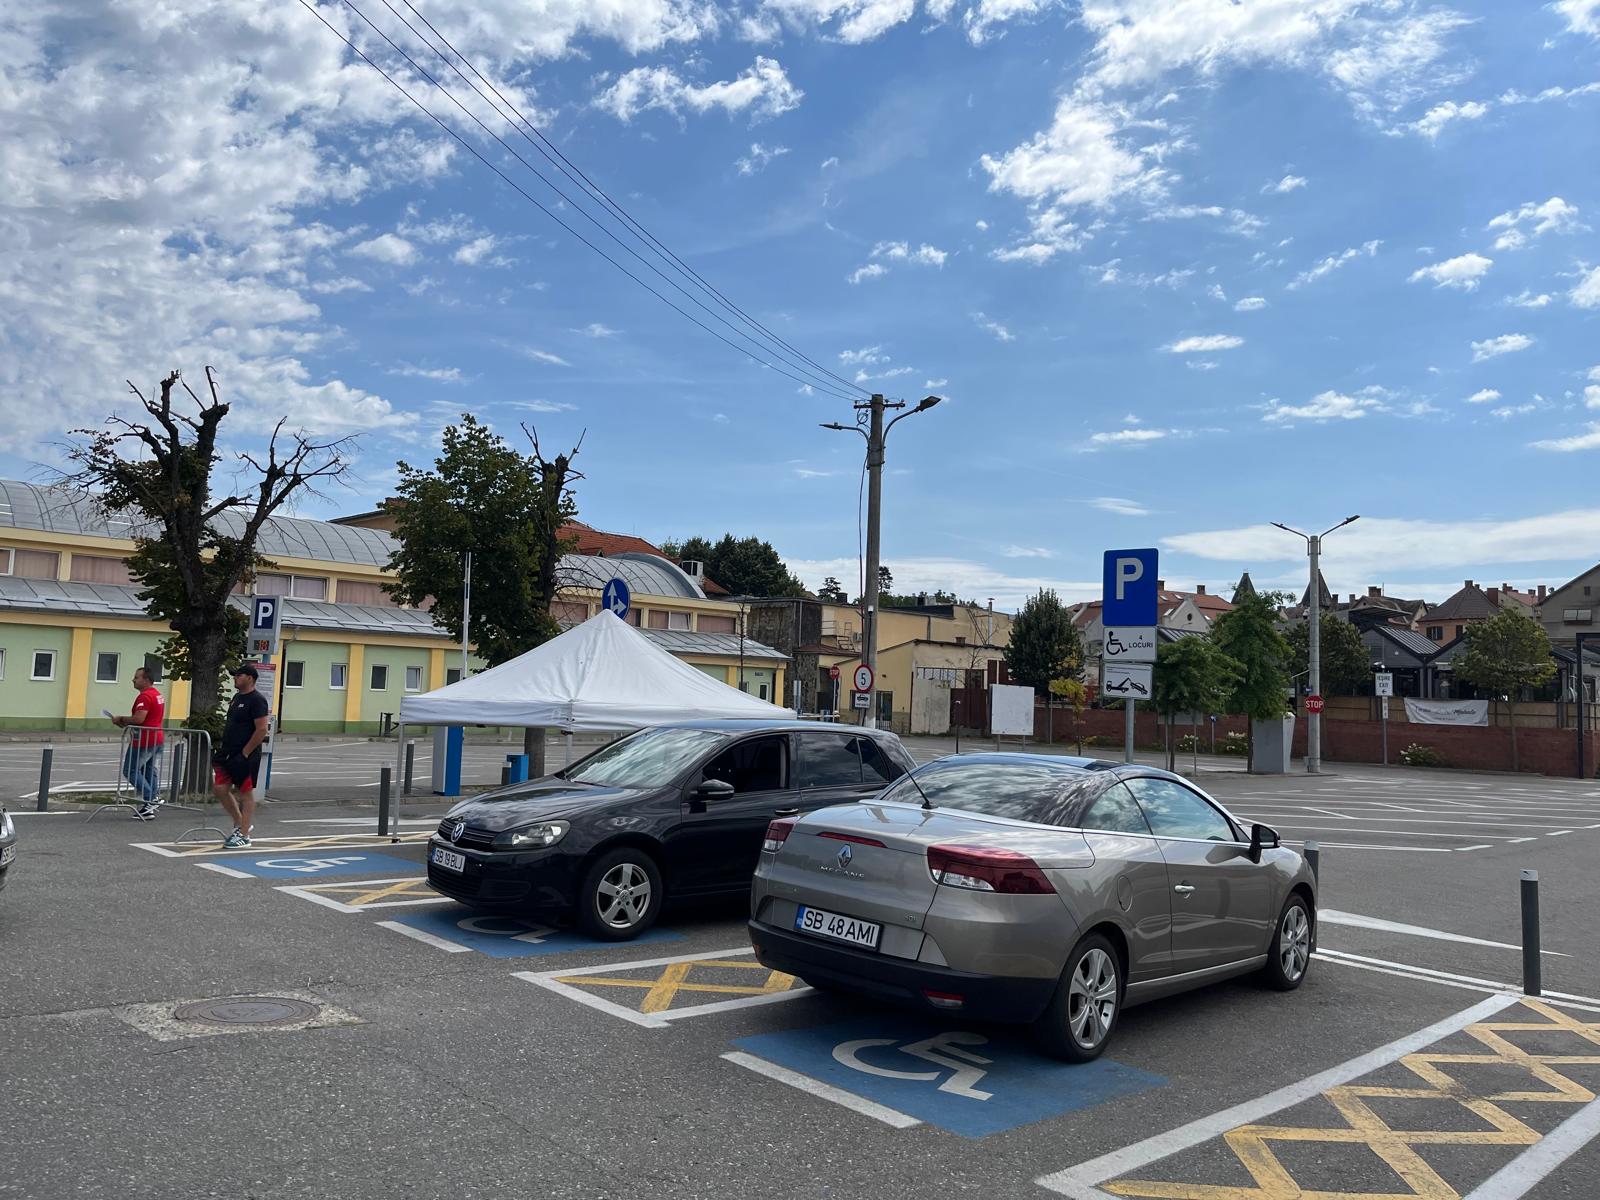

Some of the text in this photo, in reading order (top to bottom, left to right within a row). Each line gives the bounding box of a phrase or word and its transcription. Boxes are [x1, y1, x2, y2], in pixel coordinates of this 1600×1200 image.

[1116, 557, 1144, 600] P
[257, 602, 273, 626] P
[861, 673, 866, 686] 5
[1305, 701, 1324, 709] STOP
[436, 849, 444, 863] SB
[804, 910, 824, 930] SB
